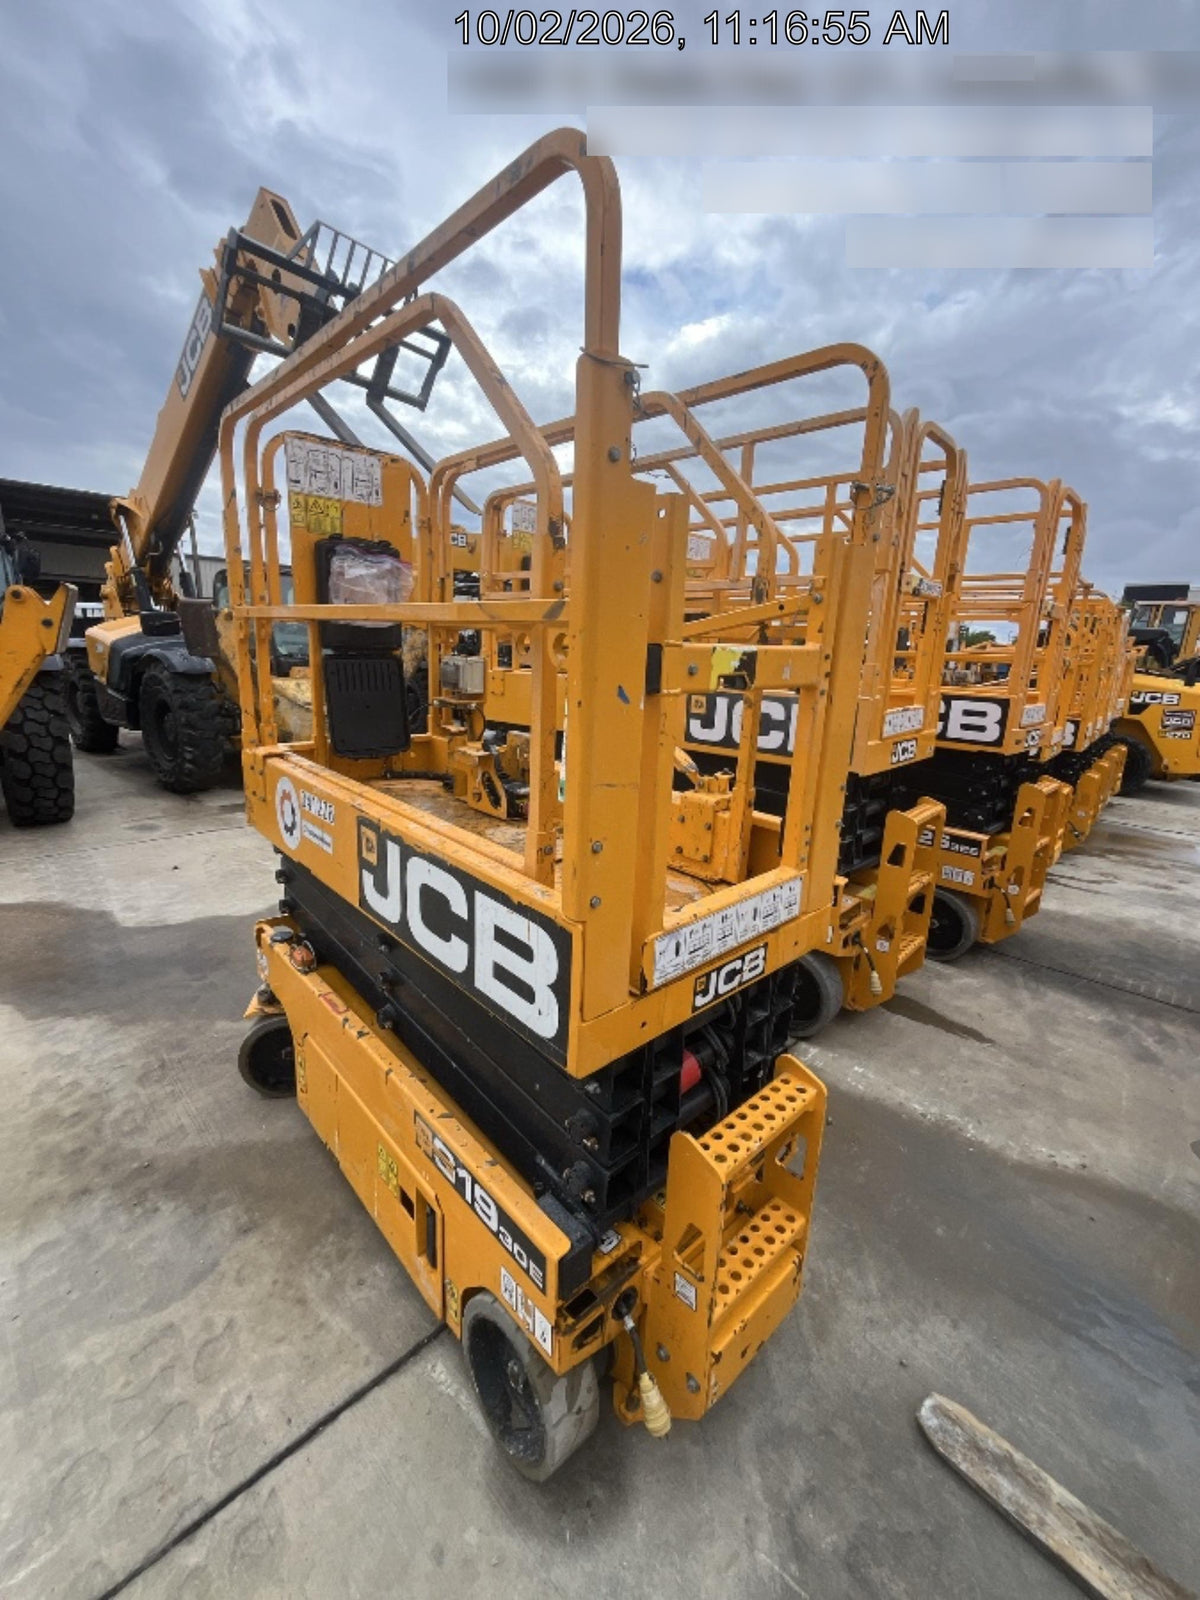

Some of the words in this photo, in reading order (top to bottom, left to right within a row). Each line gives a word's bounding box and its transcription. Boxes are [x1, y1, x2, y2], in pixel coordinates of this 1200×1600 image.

[689, 694, 797, 750] JC
[1131, 692, 1180, 705] JCB
[892, 739, 917, 764] JCB
[362, 839, 559, 1039] JCB
[694, 947, 766, 1008] JCB
